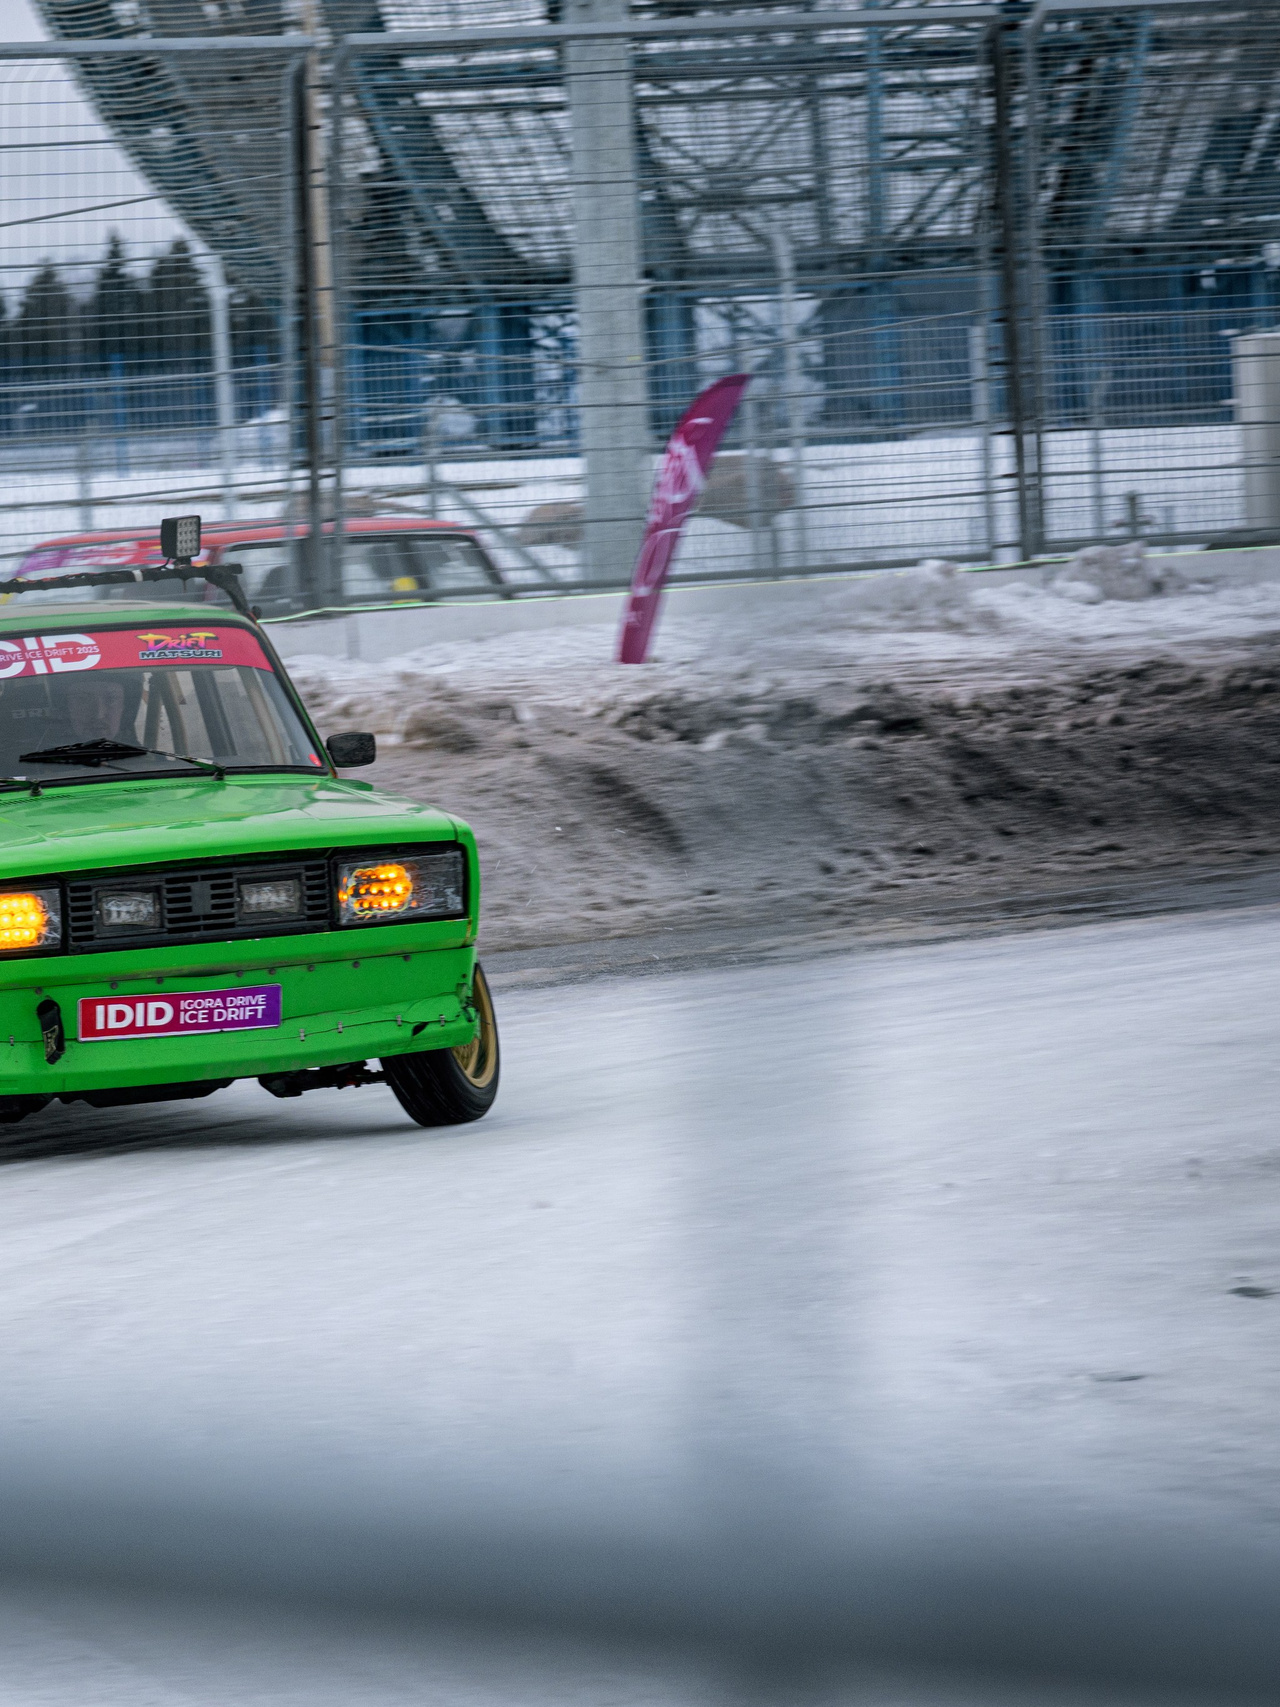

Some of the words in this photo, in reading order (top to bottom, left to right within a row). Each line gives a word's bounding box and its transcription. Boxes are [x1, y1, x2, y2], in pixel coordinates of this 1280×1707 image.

[25, 650, 42, 660] ICE
[44, 647, 74, 658] DRIFT
[76, 645, 100, 655] 2025
[139, 649, 223, 660] MATSURI
[95, 1001, 174, 1030] IDID
[180, 998, 222, 1010] IGORA
[226, 994, 266, 1007] DRIVE
[179, 1010, 209, 1025] ICE
[213, 1005, 266, 1022] DRIFT
